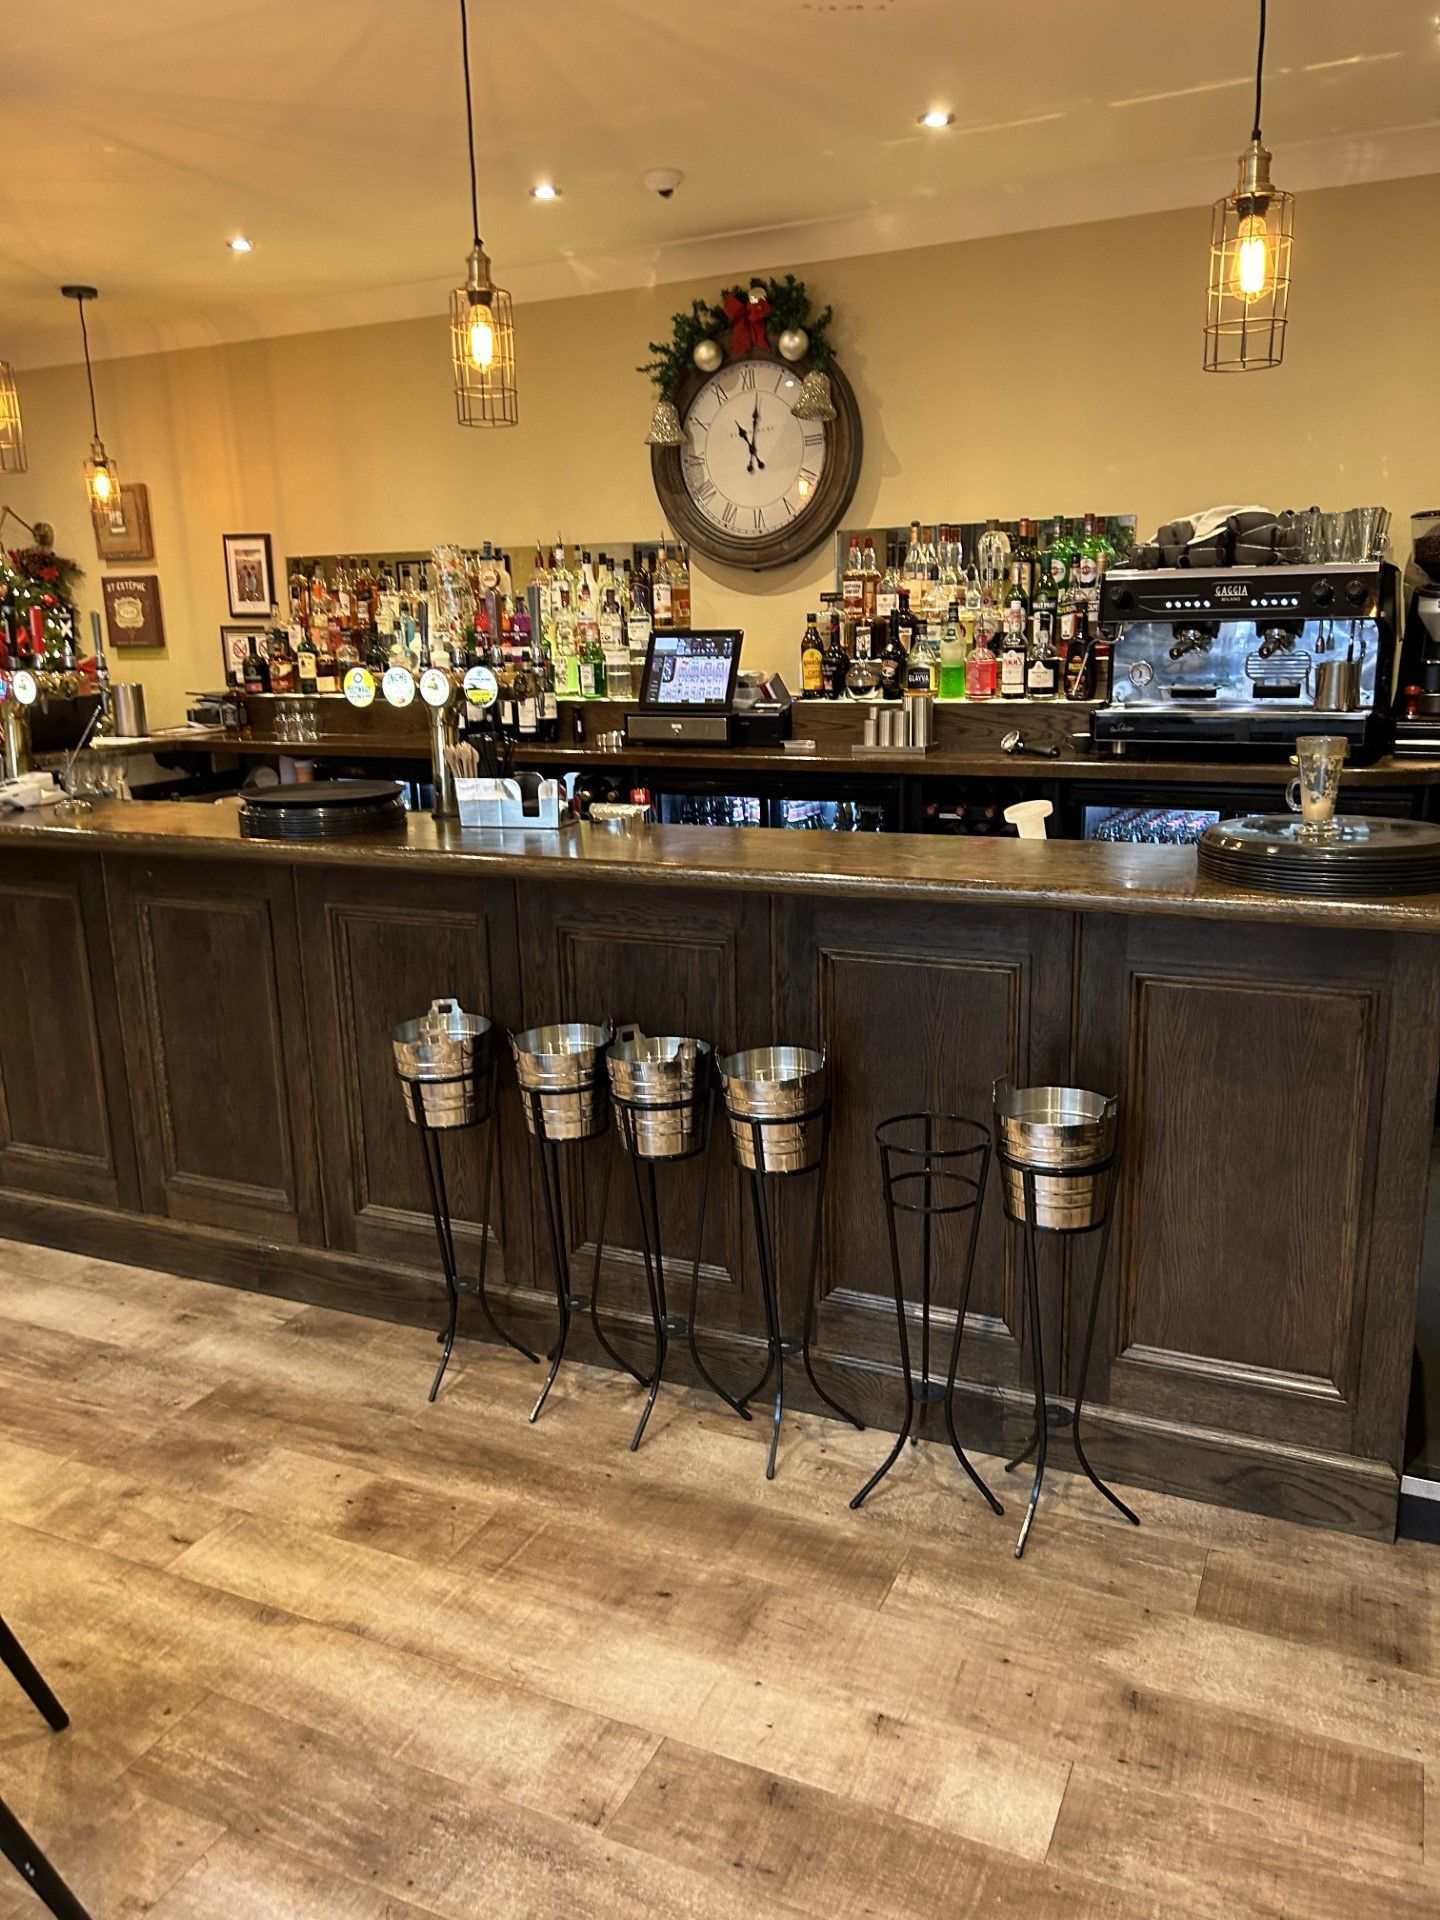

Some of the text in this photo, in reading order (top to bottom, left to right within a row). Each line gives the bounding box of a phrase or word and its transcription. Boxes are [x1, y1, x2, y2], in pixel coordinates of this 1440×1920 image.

[740, 369, 756, 391] XII
[1214, 585, 1249, 597] GAGGIA
[908, 674, 929, 683] GLAYVA
